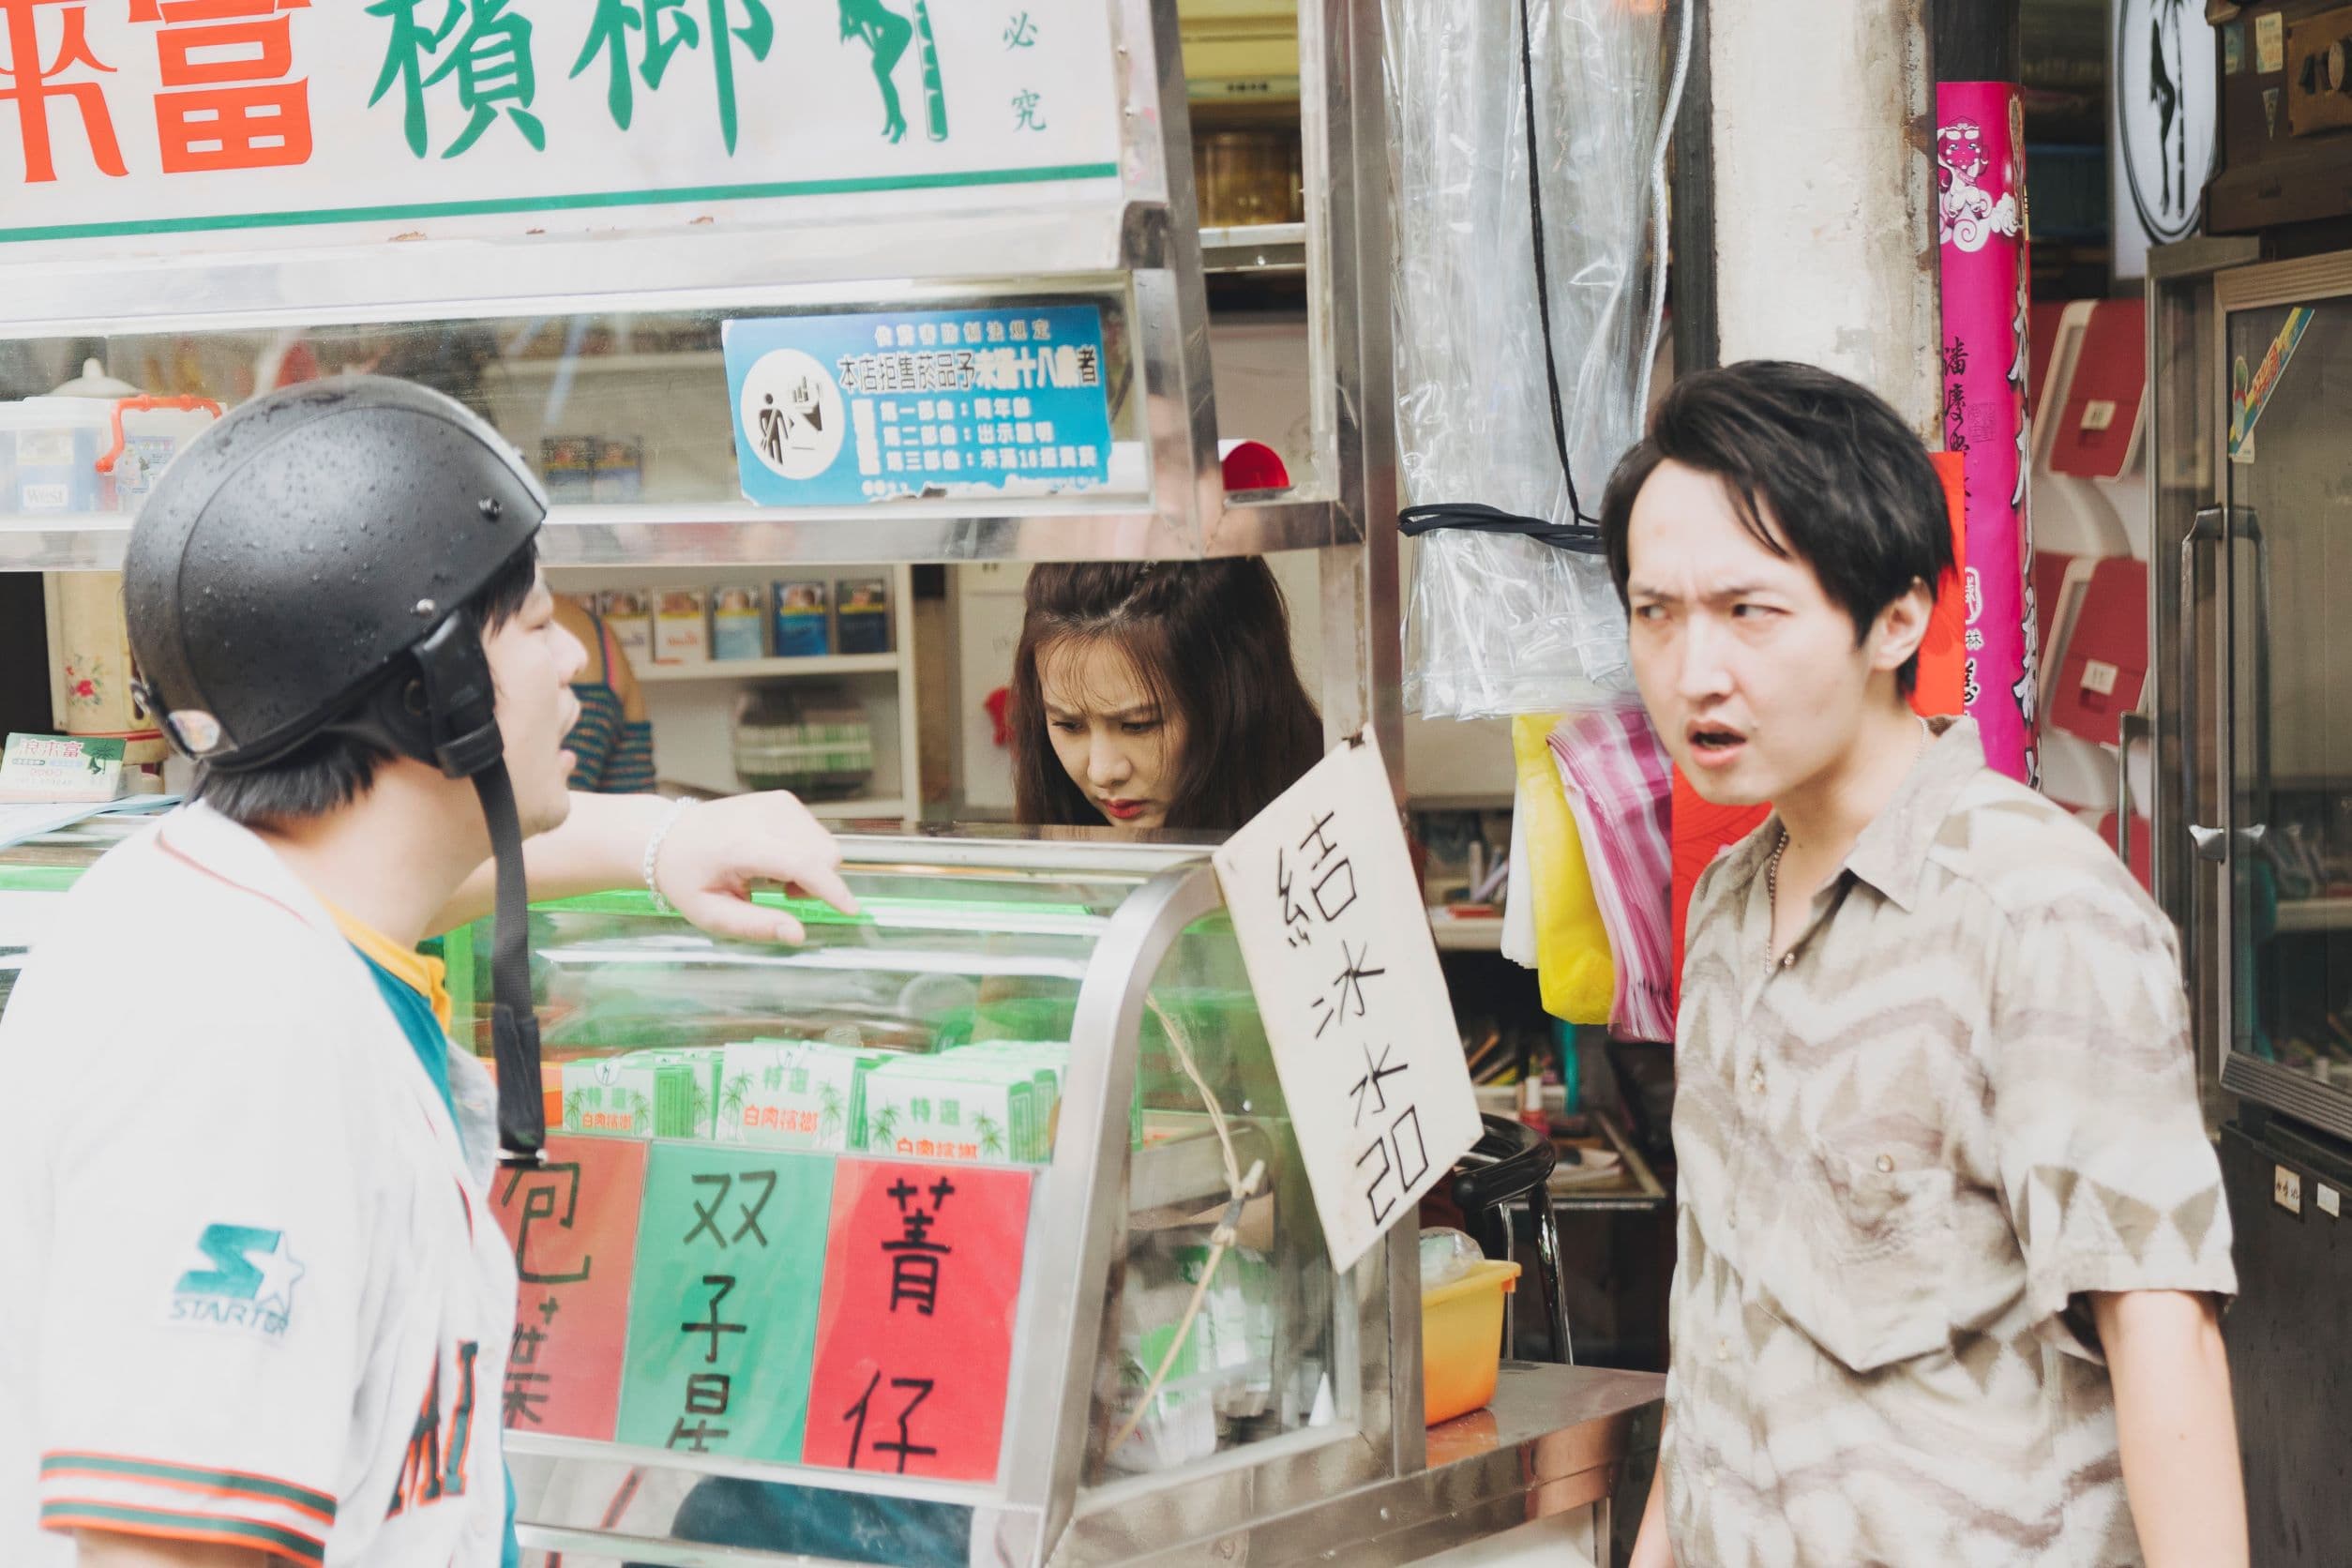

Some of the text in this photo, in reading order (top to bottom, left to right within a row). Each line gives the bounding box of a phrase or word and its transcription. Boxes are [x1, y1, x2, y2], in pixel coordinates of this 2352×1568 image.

[366, 0, 774, 159] 檳榔
[1001, 10, 1048, 132] 必究
[844, 1176, 955, 1472] 菁仔
